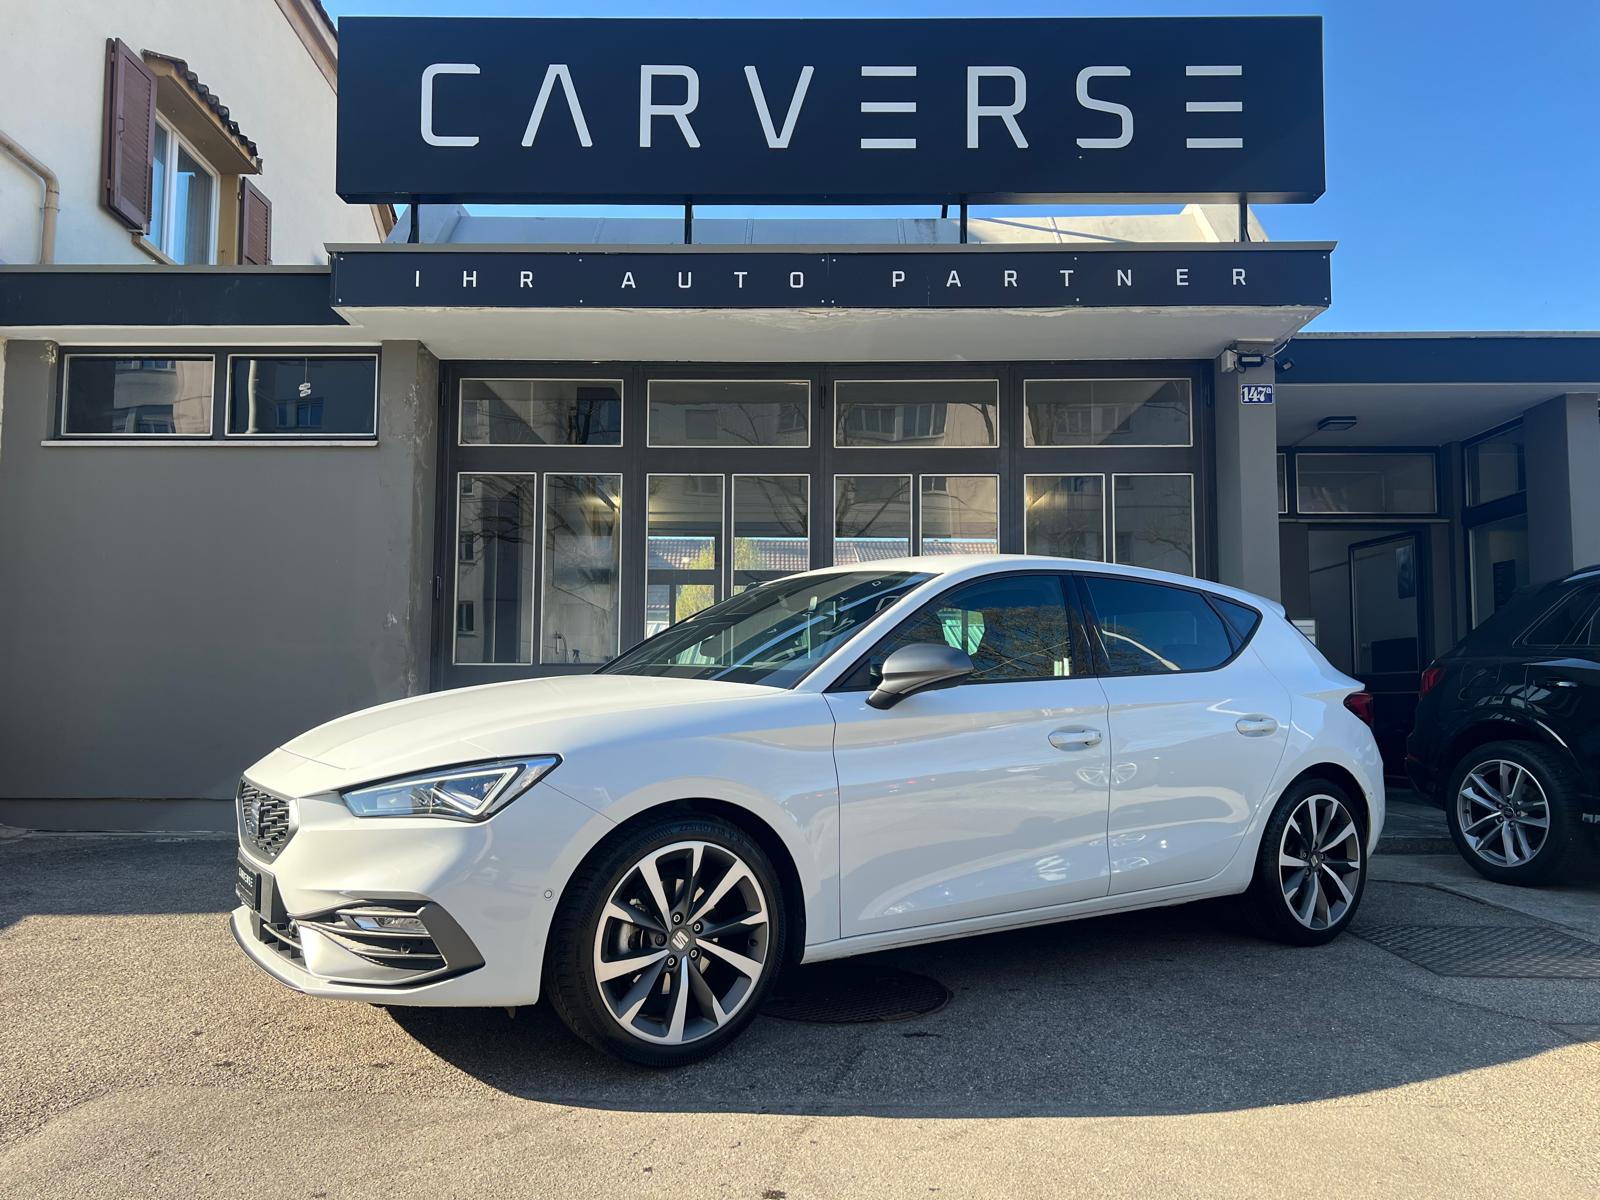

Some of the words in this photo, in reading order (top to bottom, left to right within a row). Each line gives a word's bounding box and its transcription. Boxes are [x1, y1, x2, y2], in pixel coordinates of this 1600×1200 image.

[420, 63, 1243, 149] CARVERSE
[415, 270, 534, 288] IHR
[621, 271, 804, 289] AUTO
[892, 268, 1247, 288] PARTNER
